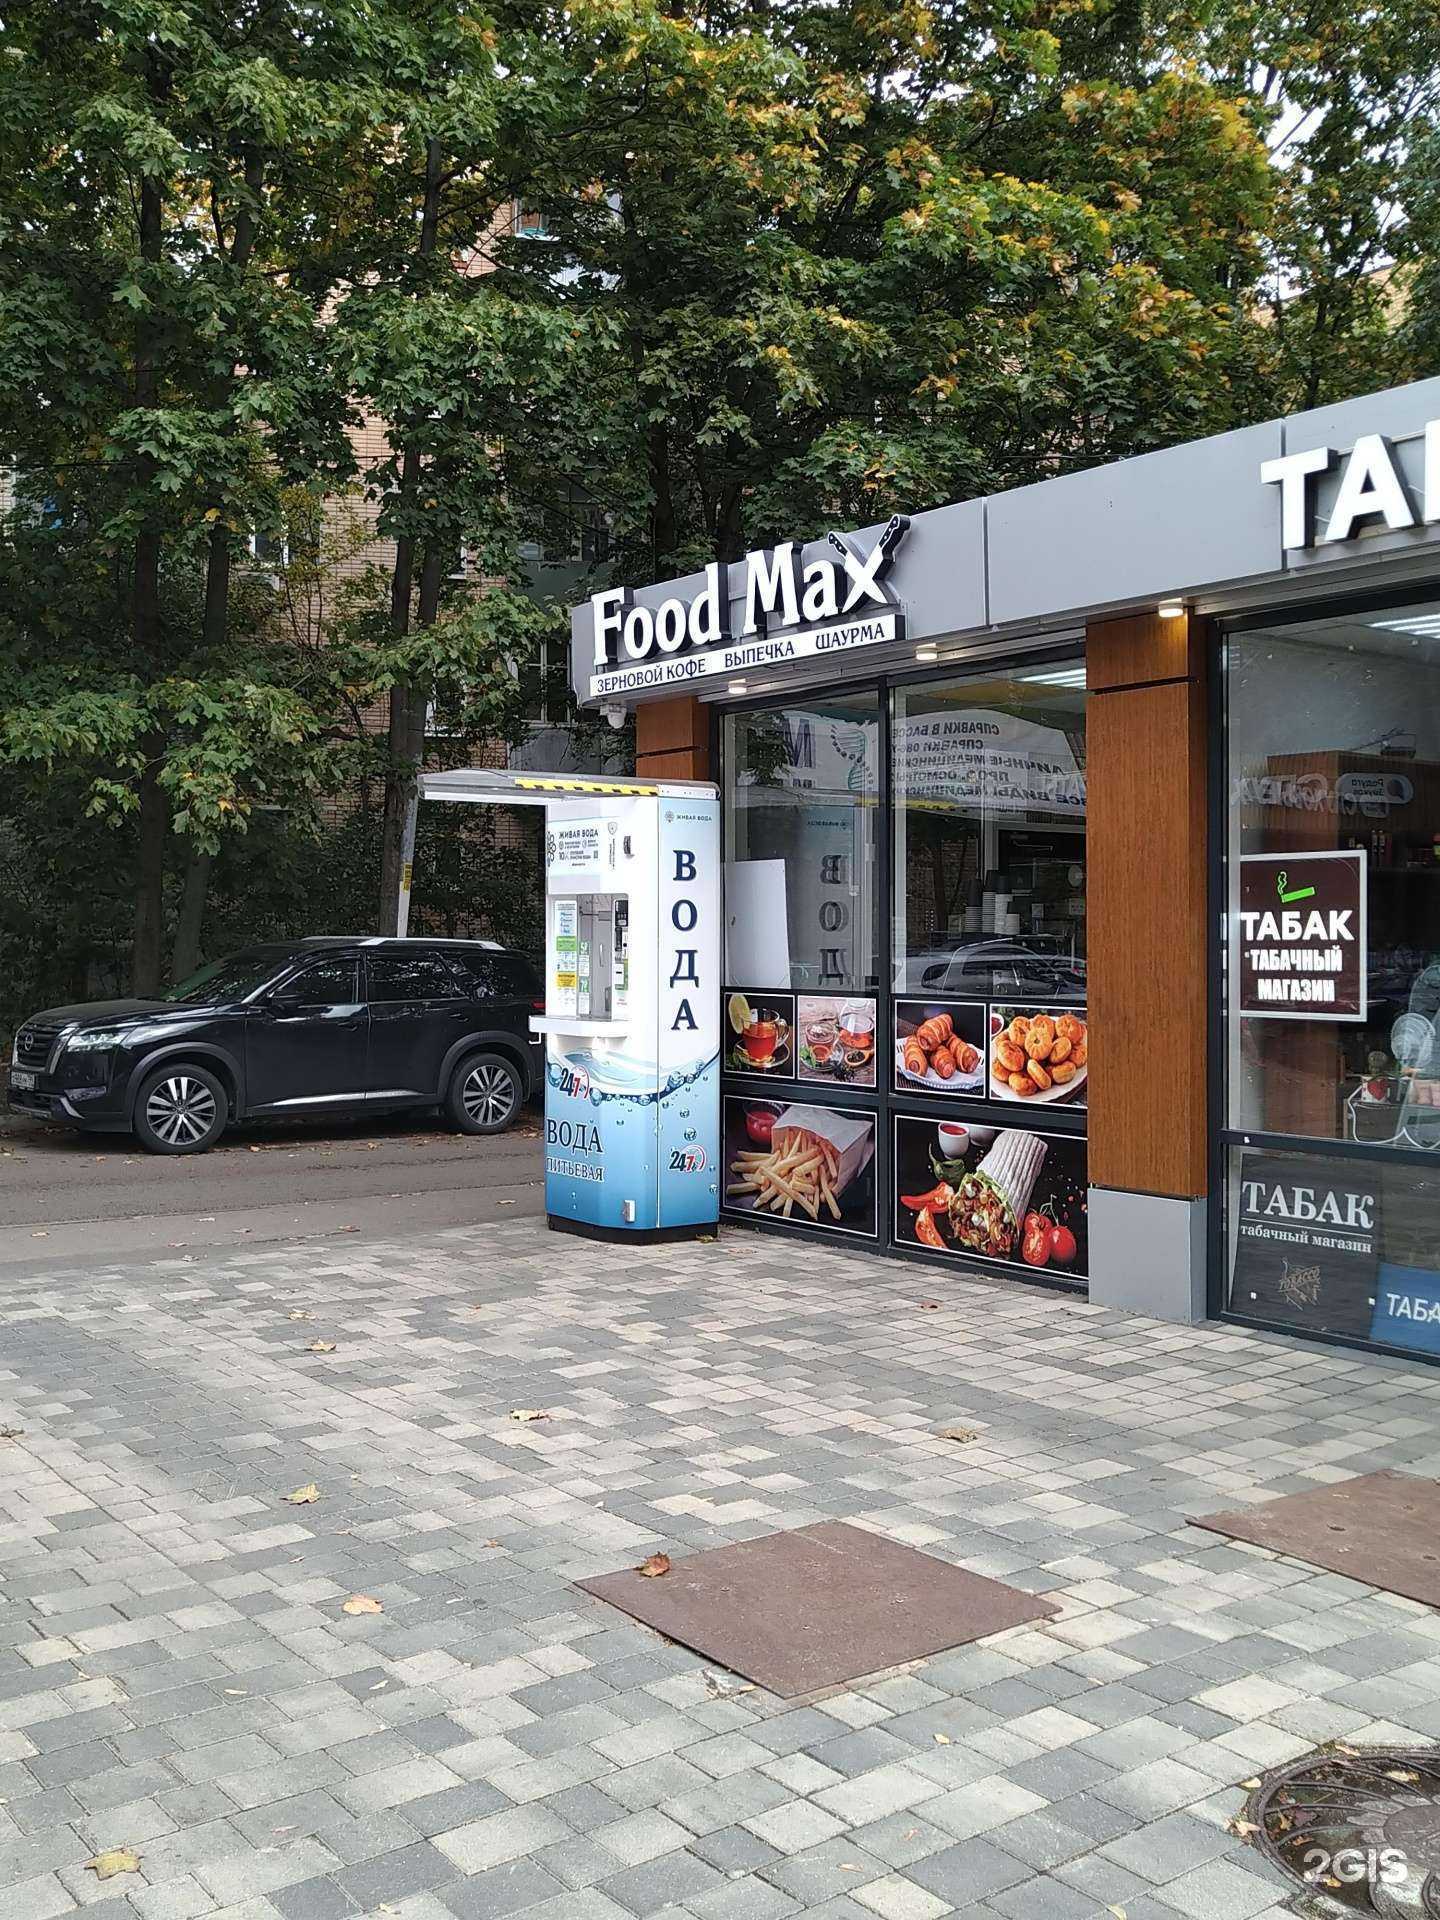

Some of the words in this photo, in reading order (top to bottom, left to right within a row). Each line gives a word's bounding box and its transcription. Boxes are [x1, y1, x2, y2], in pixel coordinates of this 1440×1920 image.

[1261, 419, 1440, 550] ТА
[591, 562, 723, 666] Food
[597, 664, 663, 693] ЗЕРНОВОЙ
[666, 658, 707, 678] КОФЕ
[724, 641, 795, 668] ВЫПЕЧКА
[815, 622, 885, 650] ШАУРМА
[669, 849, 700, 1031] ВОДА
[1240, 910, 1355, 941] ТАБАК
[1250, 945, 1343, 972] ТАБАЧНЫЙ
[1257, 978, 1335, 1001] МАГАЗИН
[546, 1118, 604, 1157] ВОДА
[546, 1157, 604, 1181] ПИТЬЕВАЯ
[1242, 1181, 1375, 1229] ТАБАК
[1240, 1224, 1309, 1244] табачный
[1312, 1235, 1373, 1254] магазин
